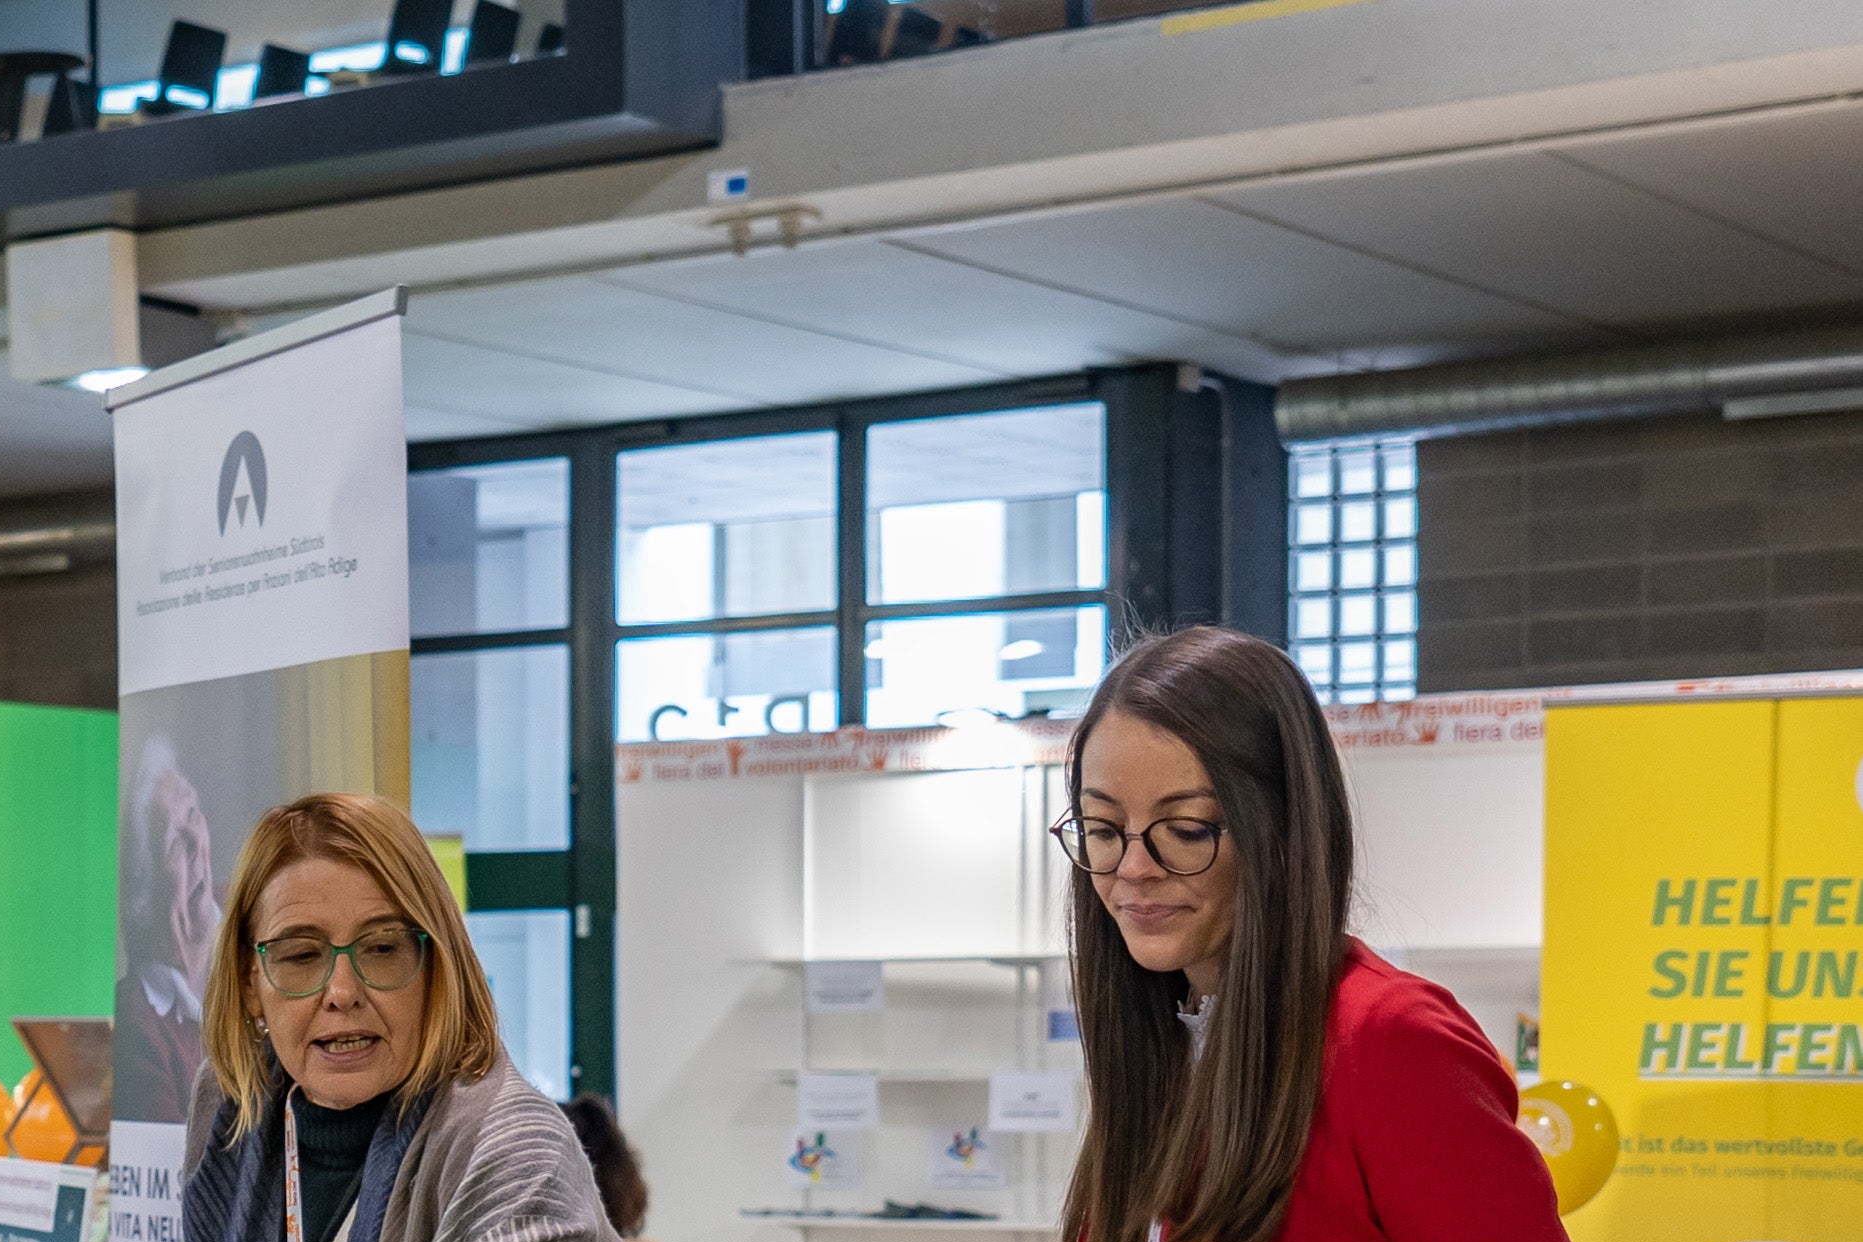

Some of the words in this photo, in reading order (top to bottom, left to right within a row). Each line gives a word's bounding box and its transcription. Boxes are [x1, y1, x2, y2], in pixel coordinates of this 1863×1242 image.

[1650, 878, 1863, 926] HELFE
[1648, 949, 1750, 998] SIE
[1767, 950, 1863, 998] UN
[147, 1167, 170, 1201] IM
